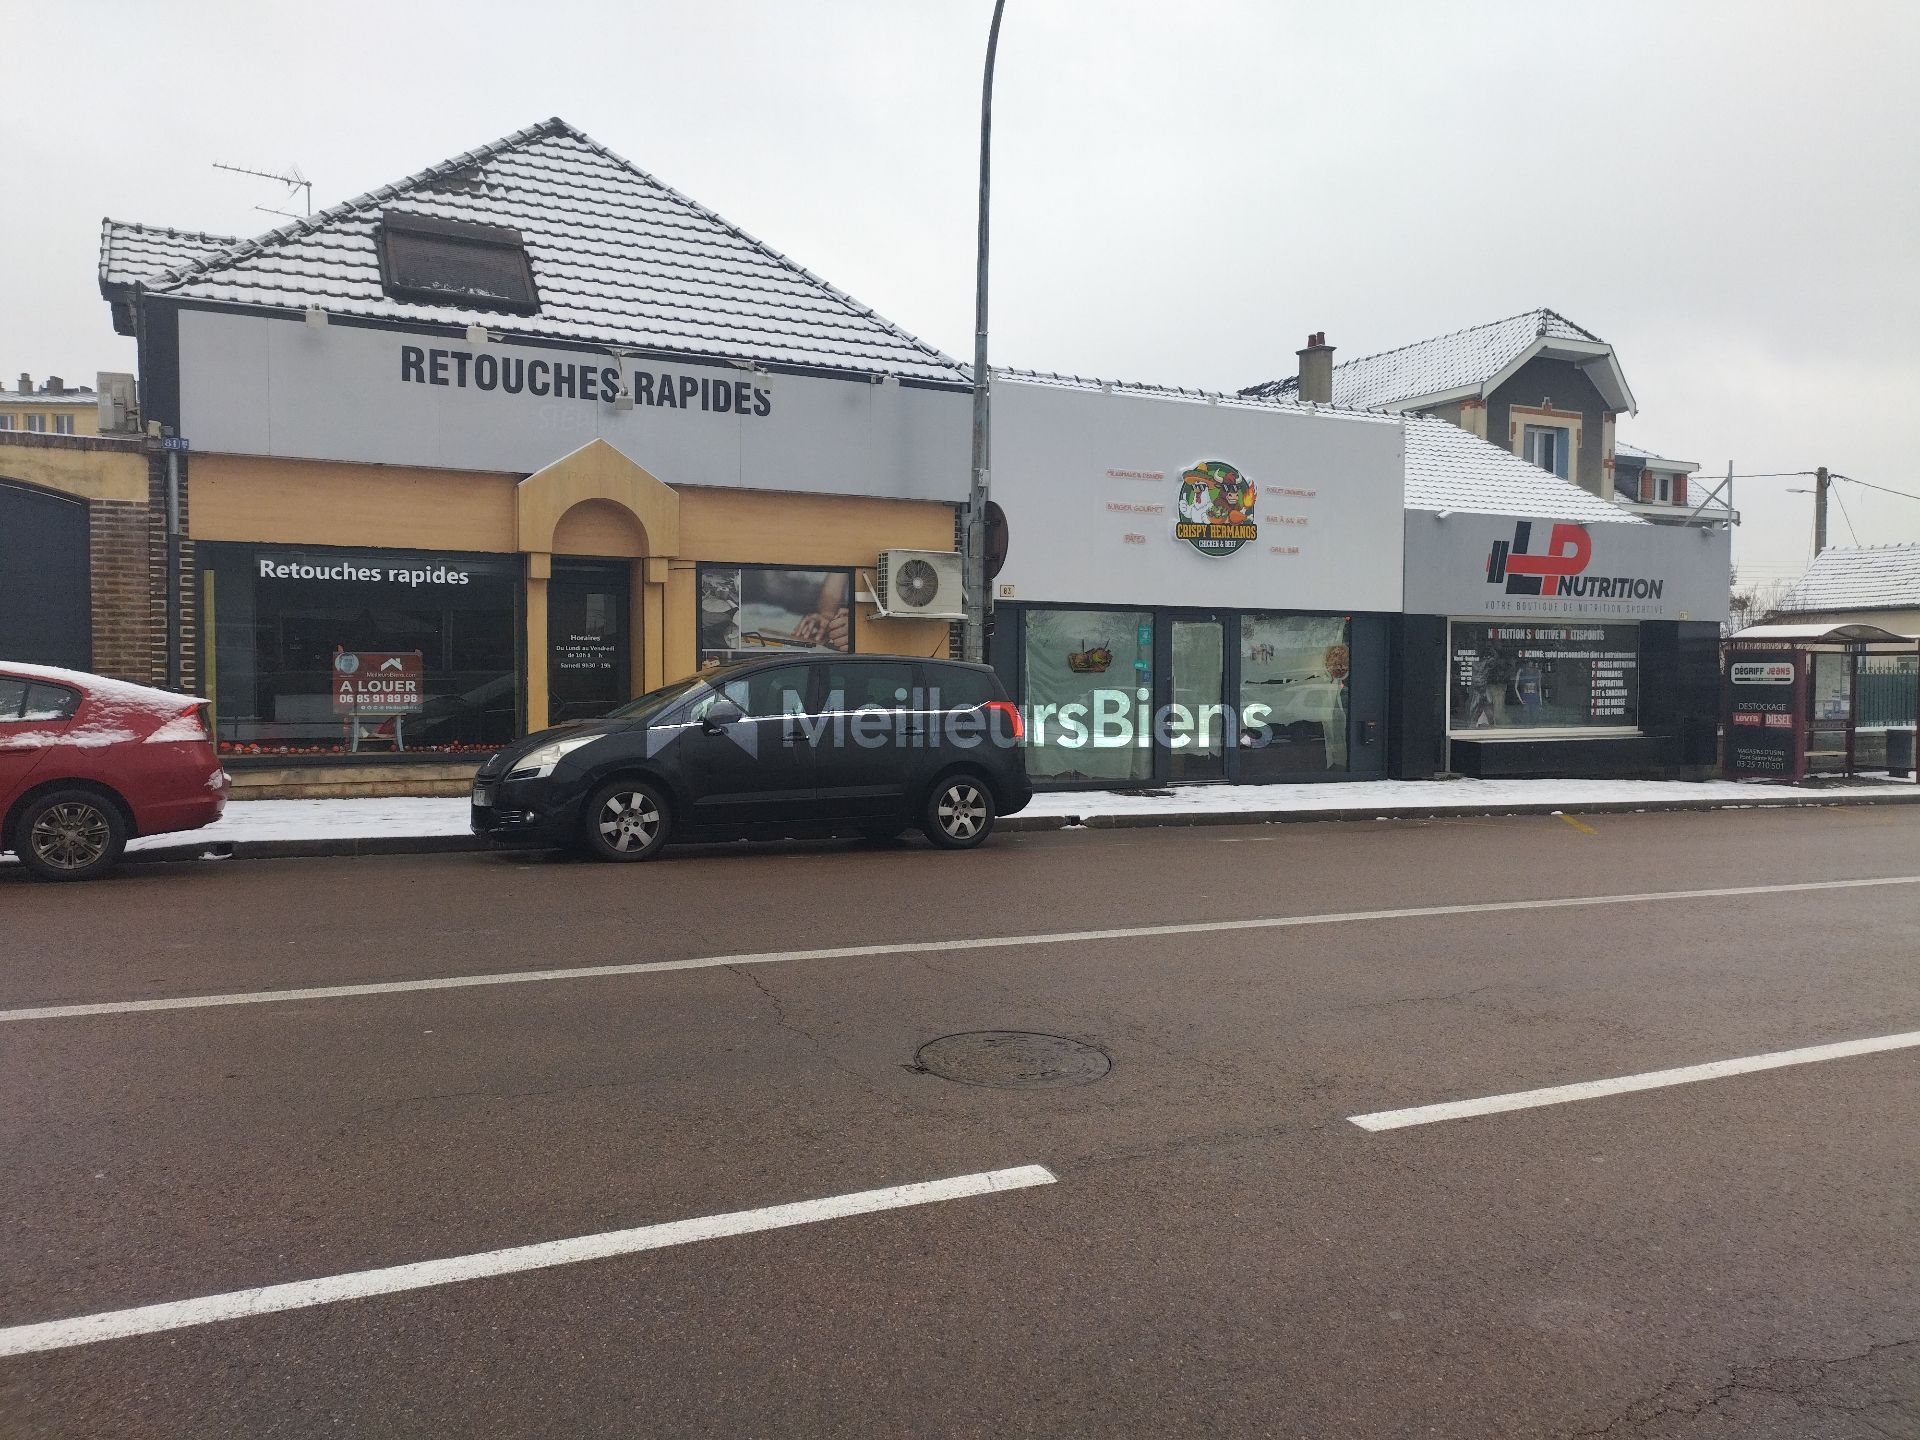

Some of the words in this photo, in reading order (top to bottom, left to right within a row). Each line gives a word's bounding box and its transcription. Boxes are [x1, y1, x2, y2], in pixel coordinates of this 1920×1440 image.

[401, 345, 620, 403] RETOUCHES
[634, 371, 771, 417] RAPIDES
[1177, 524, 1207, 538] CRISPY
[1210, 524, 1257, 539] HERMANOS
[1198, 540, 1219, 548] CHICKEN
[1225, 540, 1237, 548] BEEF
[260, 559, 382, 581] Retouches
[388, 565, 469, 588] rapides
[1557, 576, 1664, 599] NUTRITION
[1485, 600, 1511, 610] VOTRE
[1516, 601, 1558, 611] BOUTIQUE
[1563, 602, 1573, 611] DE
[1578, 603, 1621, 613] NUTRITION
[1626, 604, 1664, 614] SPORTIVE
[340, 680, 353, 692] A
[358, 680, 417, 692] LOUER
[340, 694, 354, 703] 06
[356, 694, 370, 703] 85
[372, 694, 384, 703] 91
[387, 694, 400, 703] 89
[403, 694, 418, 703] 98
[1738, 702, 1787, 711] DESTOCKAGE
[1765, 714, 1791, 725] DIESEL
[1736, 760, 1745, 768] 03
[1757, 761, 1770, 769] 710
[1771, 762, 1784, 770] 501
